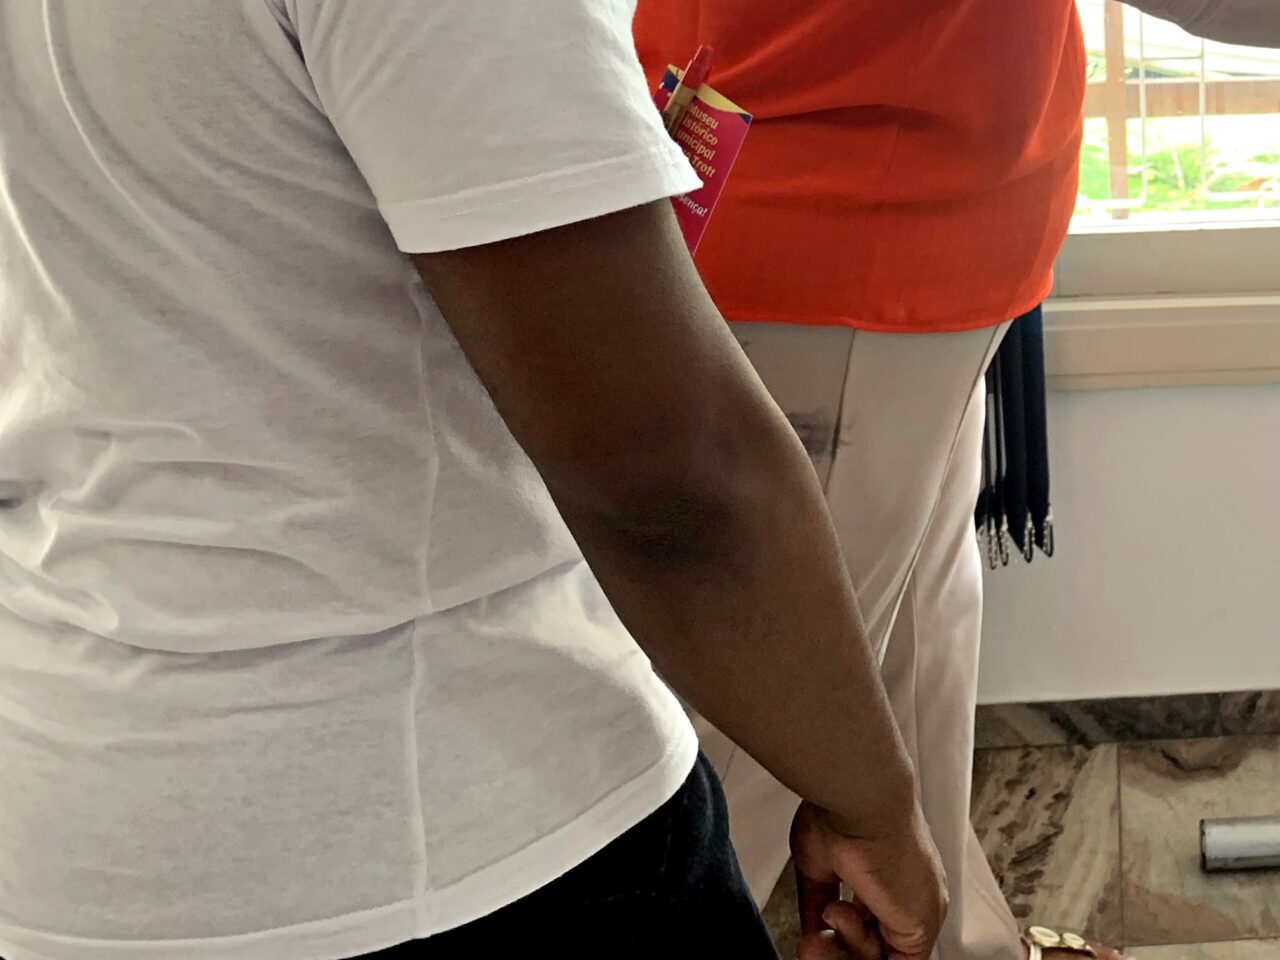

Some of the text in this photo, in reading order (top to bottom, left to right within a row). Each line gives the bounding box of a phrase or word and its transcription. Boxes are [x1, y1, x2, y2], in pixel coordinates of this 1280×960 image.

[690, 103, 719, 130] Museu
[682, 116, 718, 146] istórico
[677, 130, 716, 160] unicipal
[692, 155, 716, 178] Trott
[678, 192, 708, 217] sença!
